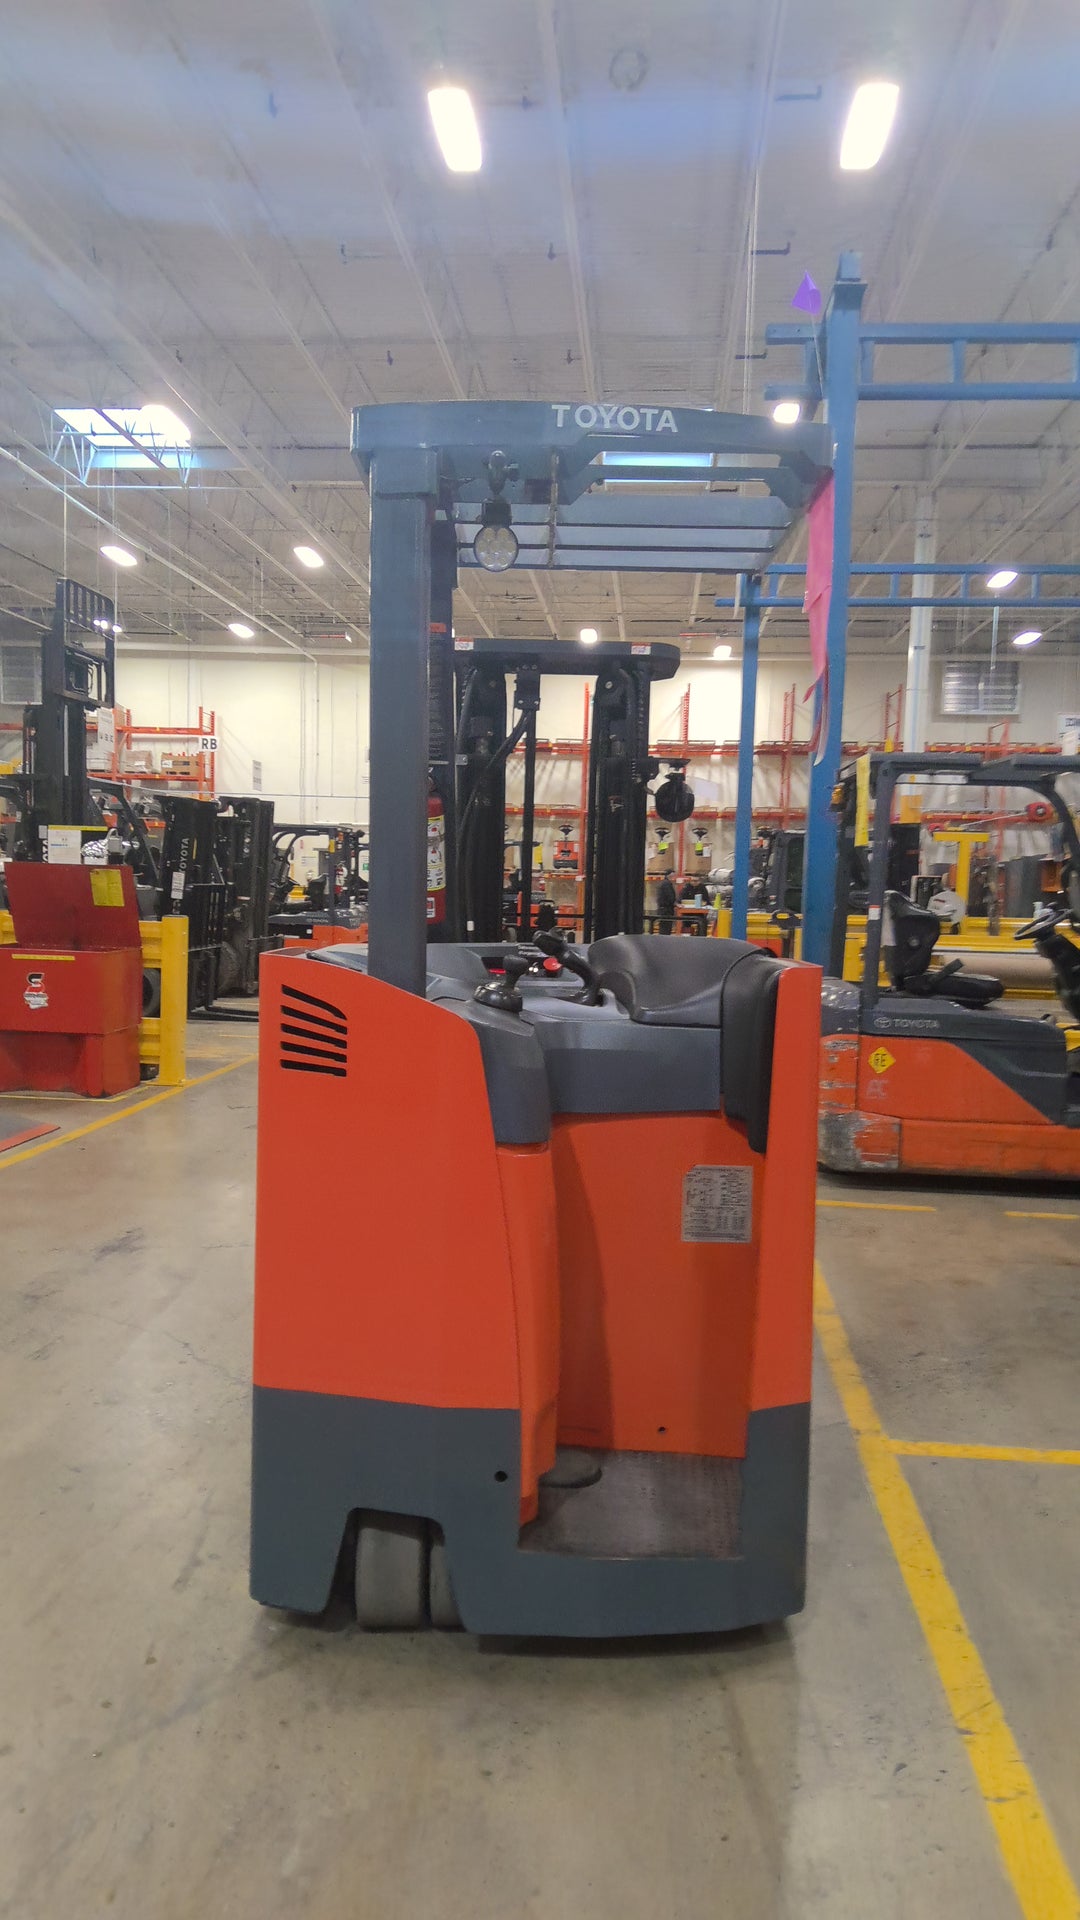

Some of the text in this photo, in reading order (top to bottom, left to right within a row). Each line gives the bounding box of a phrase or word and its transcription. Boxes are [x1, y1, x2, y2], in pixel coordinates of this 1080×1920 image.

[551, 404, 679, 433] TOYOTA
[201, 738, 218, 750] RB
[893, 1018, 939, 1029] TOYOTA
